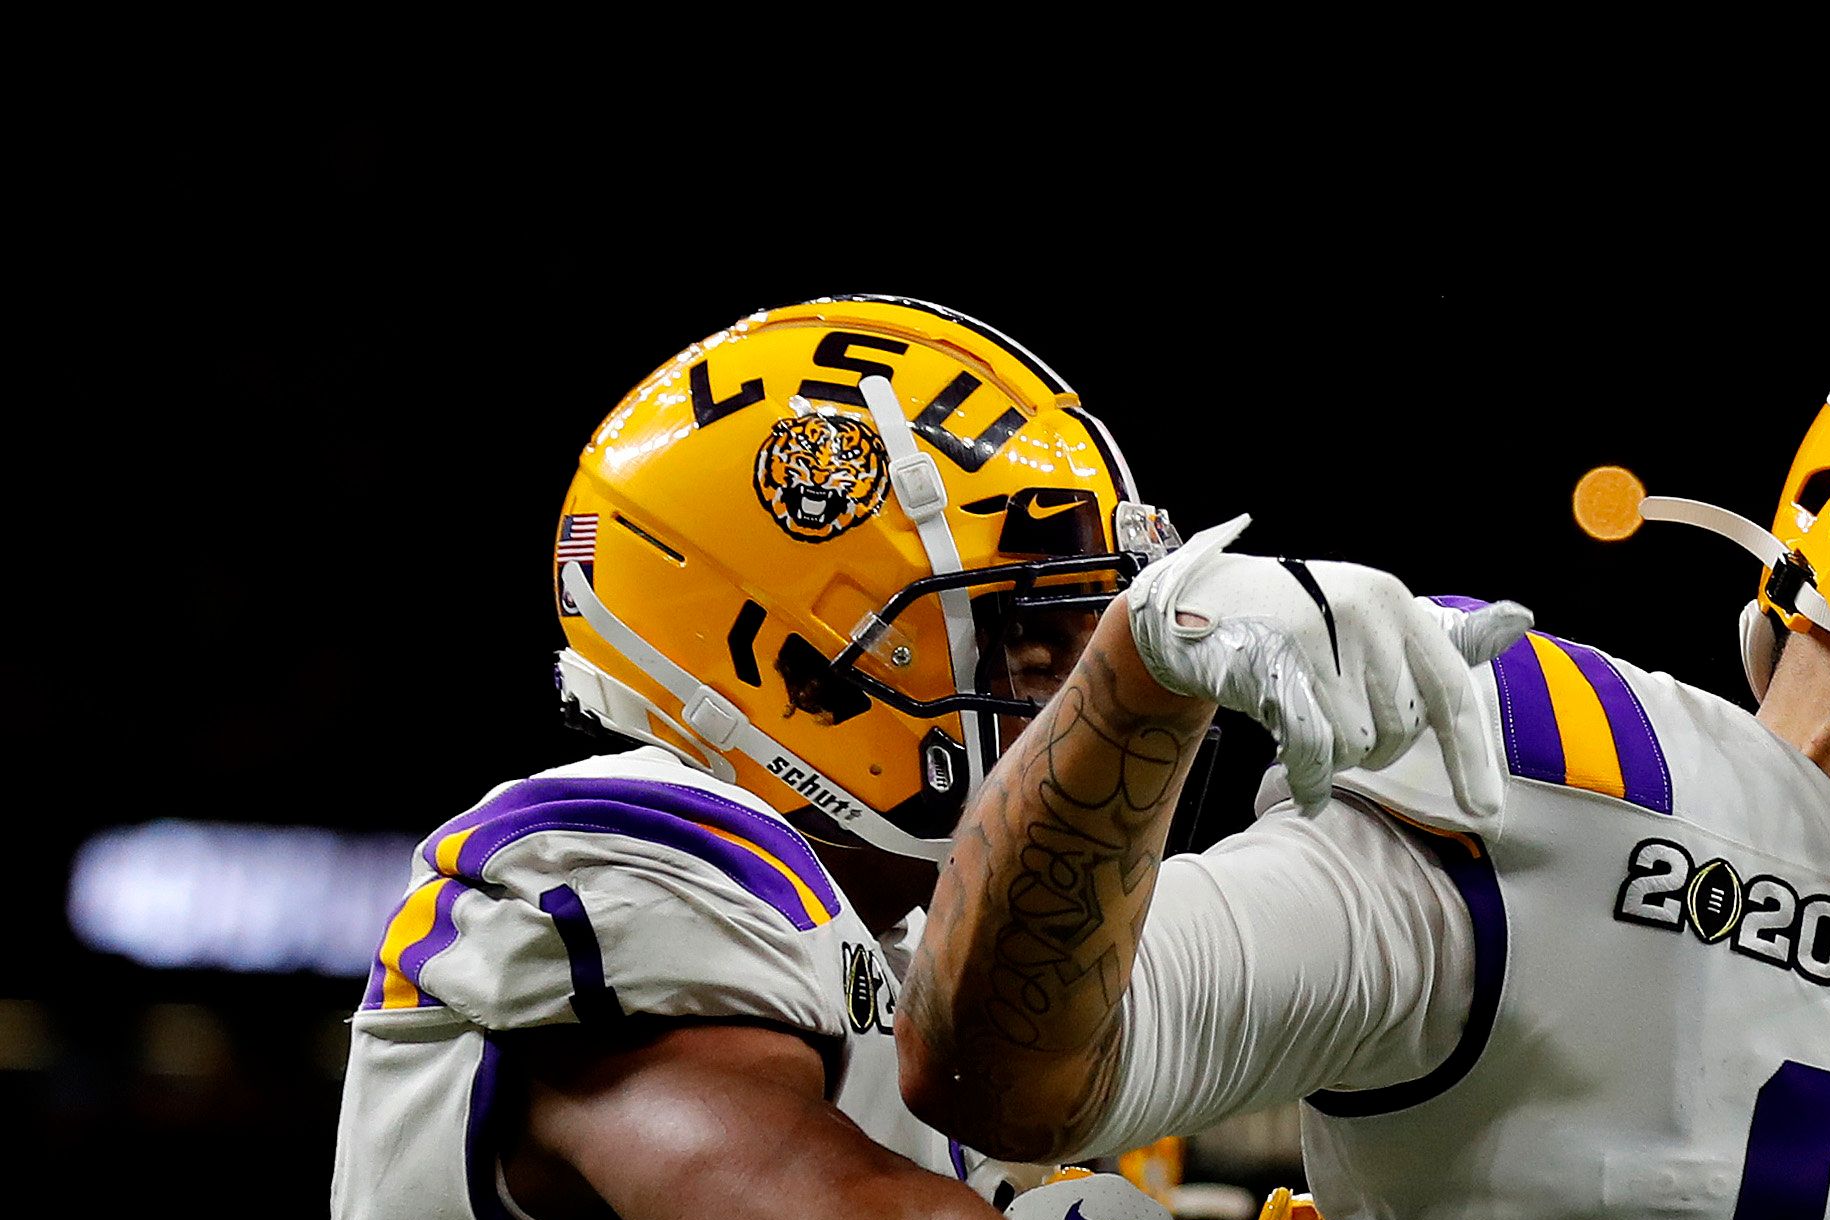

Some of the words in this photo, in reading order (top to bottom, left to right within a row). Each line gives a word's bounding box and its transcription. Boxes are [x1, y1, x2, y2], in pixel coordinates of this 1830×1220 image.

[689, 330, 1029, 473] LSU
[766, 756, 863, 821] schutt
[539, 883, 625, 1025] 1
